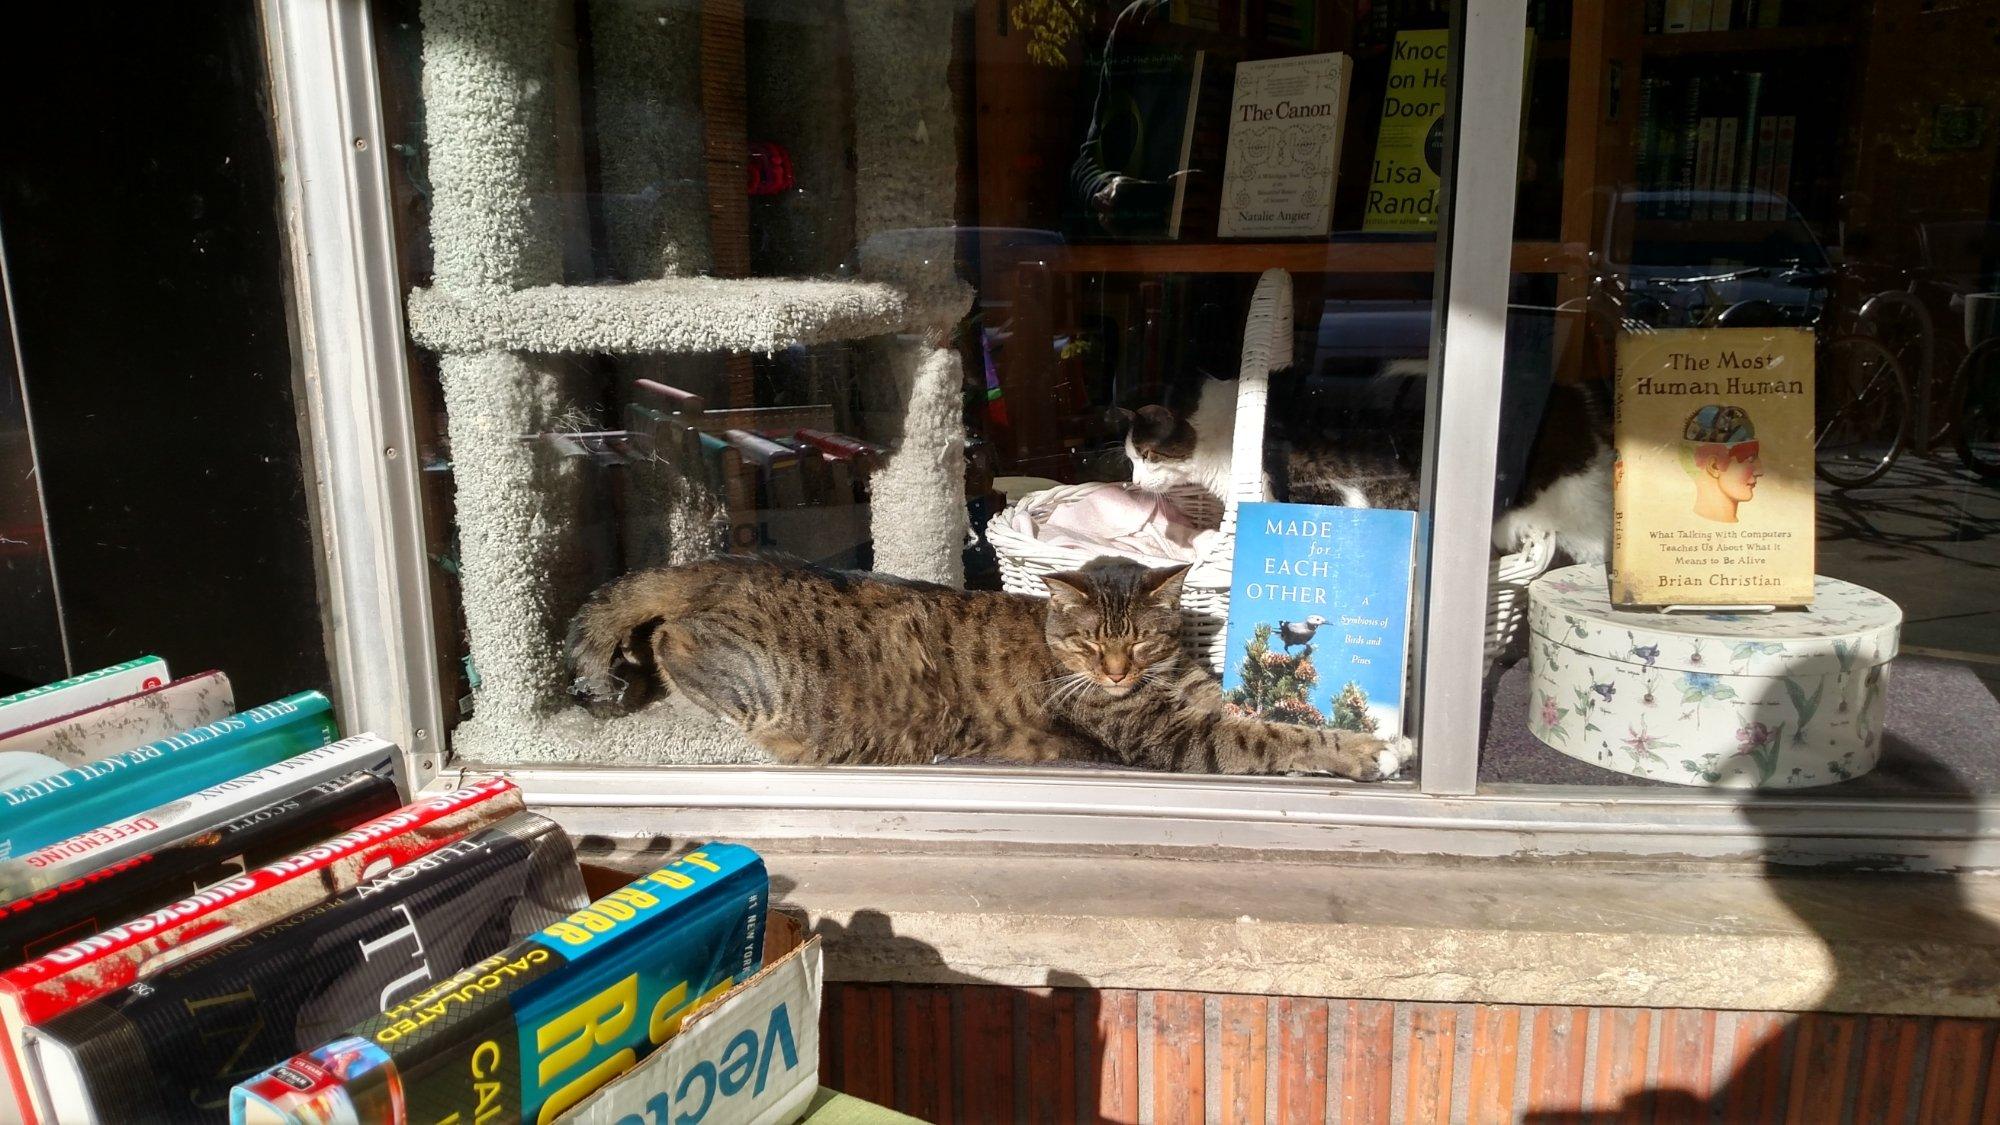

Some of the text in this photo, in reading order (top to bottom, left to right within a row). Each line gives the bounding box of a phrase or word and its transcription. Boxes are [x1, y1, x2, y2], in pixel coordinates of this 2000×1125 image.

[1394, 40, 1447, 61] Knoc
[1390, 73, 1415, 88] on
[1240, 101, 1331, 122] The Canon
[1374, 160, 1422, 184] Lisa
[1239, 210, 1311, 224] Natalie Angier
[1669, 350, 1775, 371] The Most
[1637, 377, 1804, 397] Human Human
[1265, 519, 1333, 538] MADE
[1615, 511, 1624, 551] Brian
[1649, 530, 1674, 540] What
[1676, 530, 1712, 542] Talking
[1740, 530, 1793, 541] Computers
[1308, 541, 1331, 557] for
[1660, 543, 1698, 553] Teaches
[1701, 542, 1713, 553] Us
[1716, 543, 1743, 552] About
[1746, 542, 1771, 552] What
[1264, 558, 1329, 578] EACH
[1675, 556, 1766, 565] Means to Be Alive
[1658, 573, 1782, 588] Brian Christian
[1246, 583, 1327, 604] OTHER
[1362, 597, 1369, 606] A
[1340, 615, 1389, 628] Symbiosis of
[1345, 634, 1381, 646] Birds and
[1352, 654, 1372, 665] Pines
[5, 700, 298, 806] THE SOUTH BEACH DIET
[282, 732, 378, 772] WILLIAM
[199, 763, 282, 802] LANDAY
[226, 799, 300, 833] SCOTT
[25, 816, 160, 868] DEFENDING
[265, 807, 420, 879] JOHANSEN
[356, 838, 488, 900] TUROW
[44, 875, 257, 967] QUICKSAND
[257, 896, 346, 942] PERSONAL
[542, 889, 661, 947] ROBB
[740, 894, 759, 978] #1 NEW YORK
[376, 948, 551, 1044] CALCULATED
[384, 956, 510, 1018] IN DEATH
